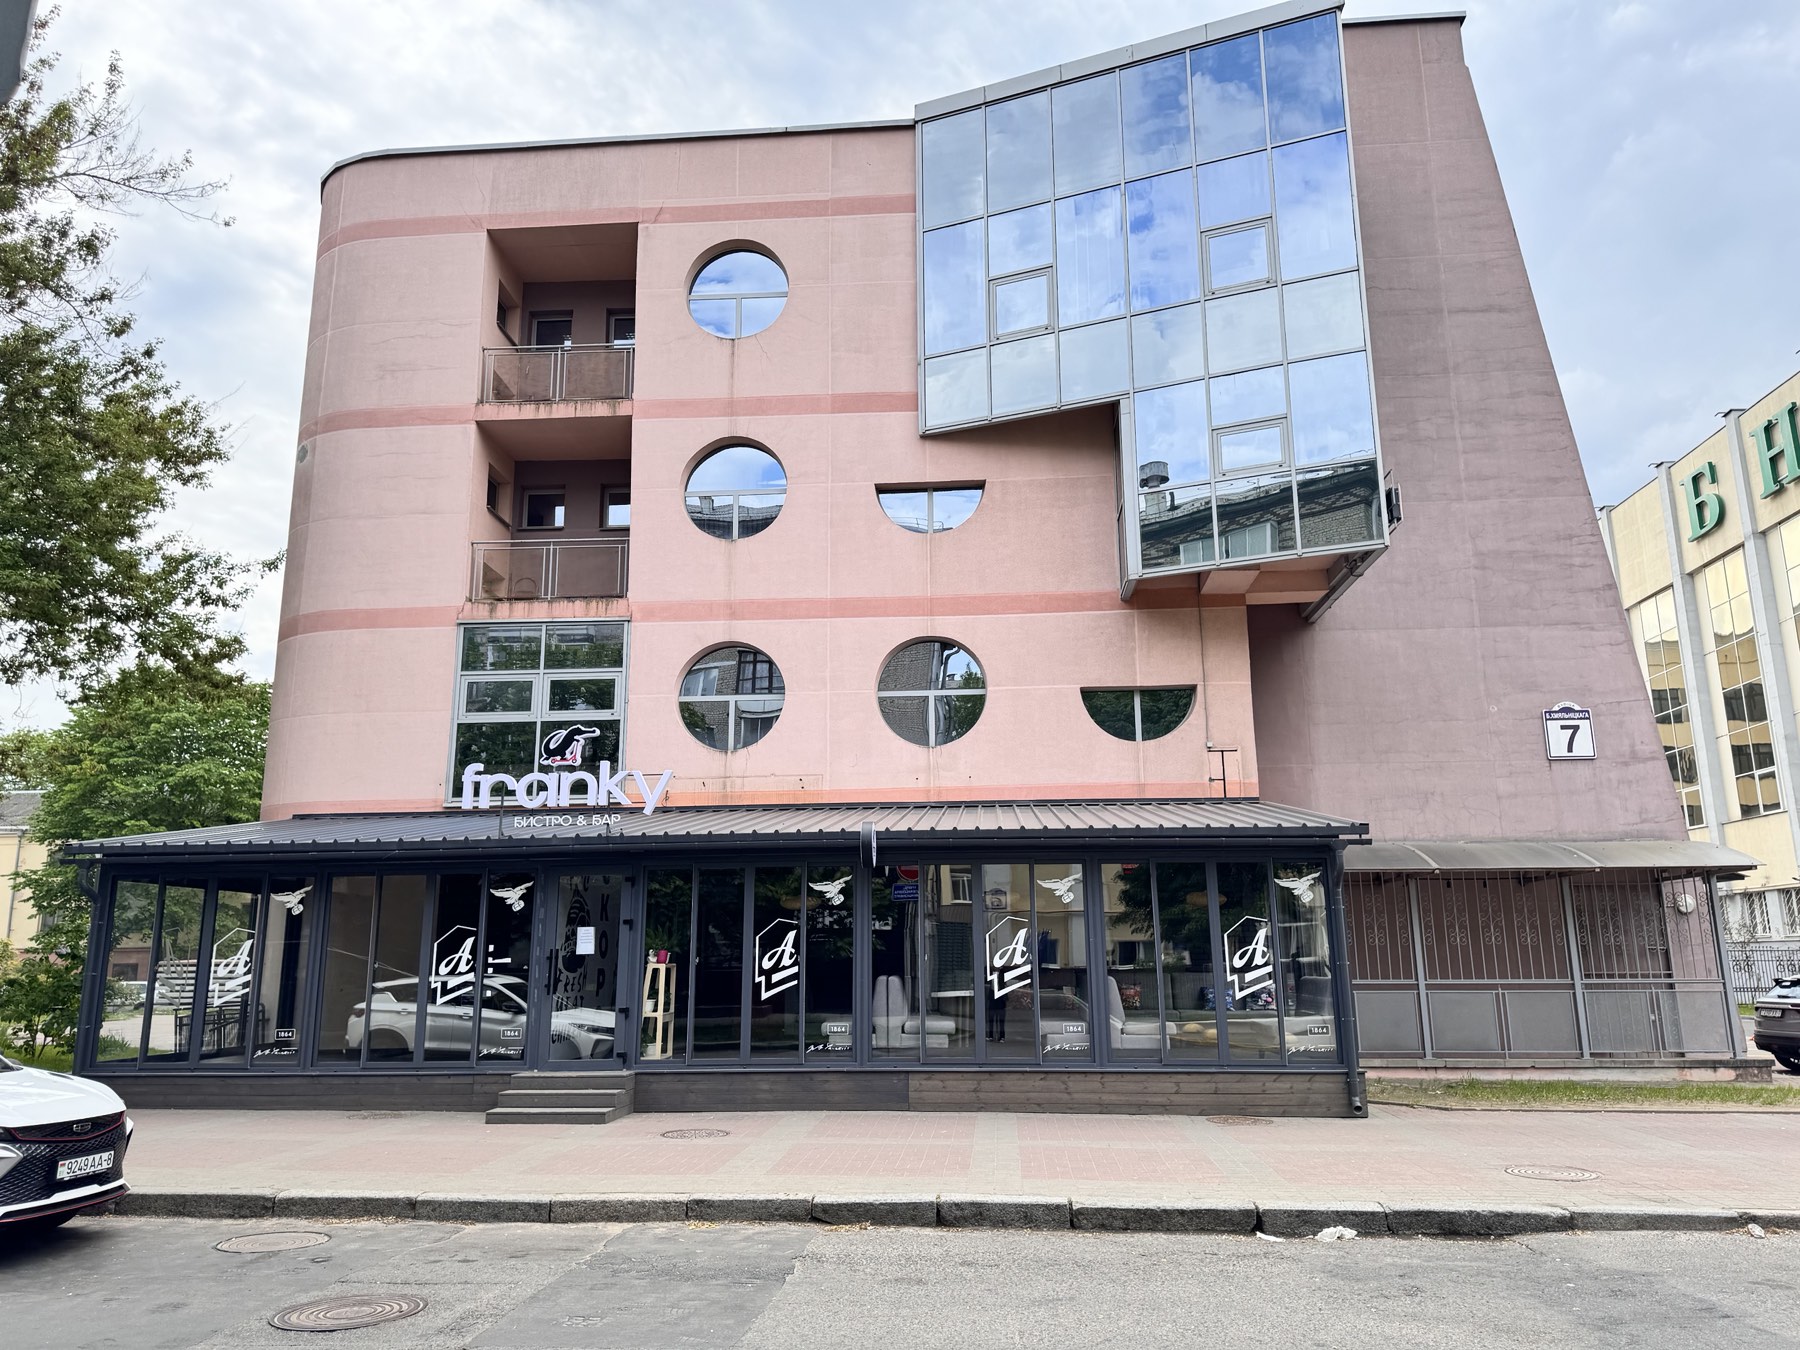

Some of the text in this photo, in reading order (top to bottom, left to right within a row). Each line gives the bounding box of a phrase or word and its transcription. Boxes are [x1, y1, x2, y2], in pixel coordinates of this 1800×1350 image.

[1560, 724, 1580, 753] 7
[461, 760, 674, 816] franky
[514, 814, 621, 828] БИСТРО & БАР
